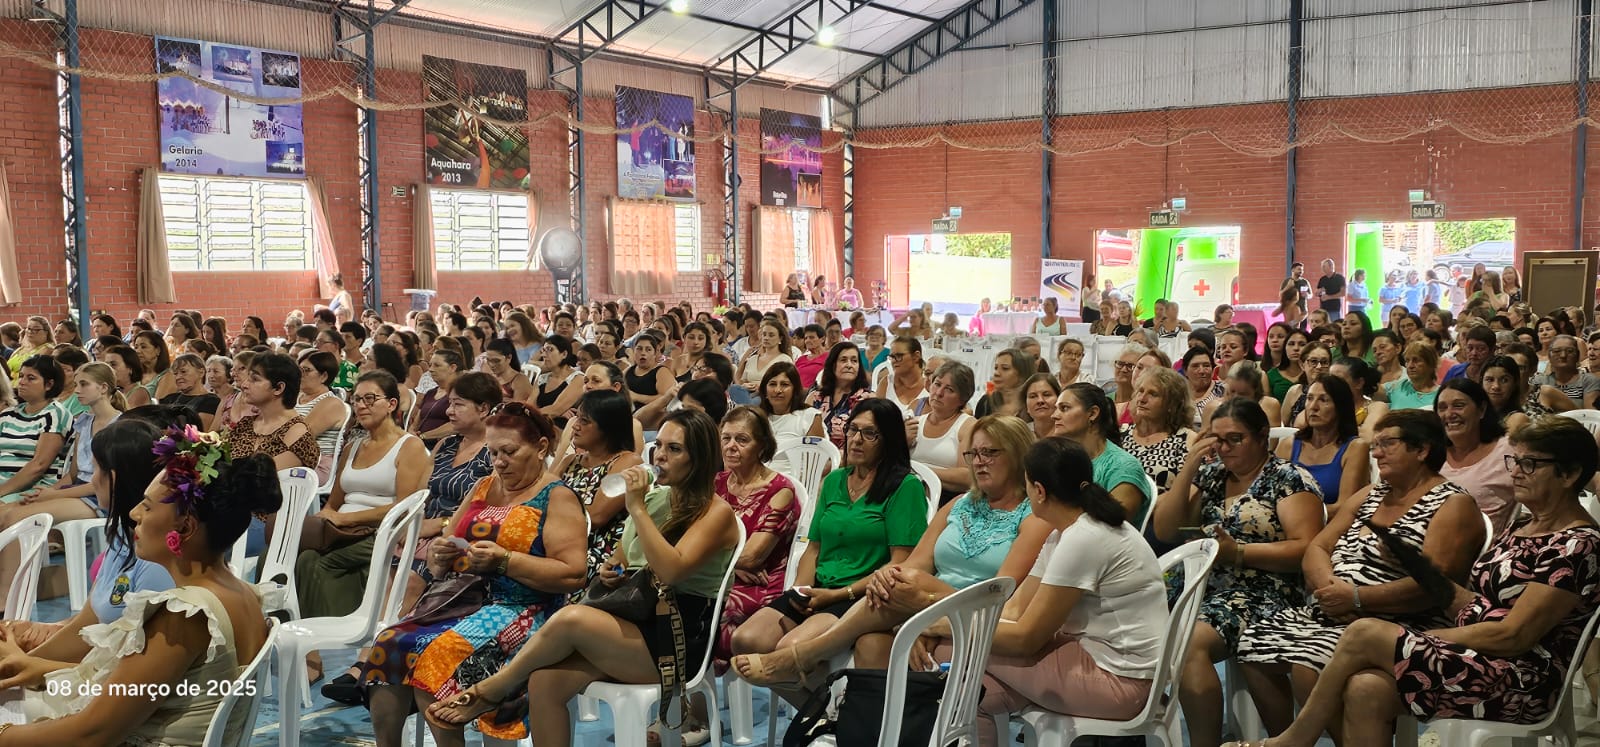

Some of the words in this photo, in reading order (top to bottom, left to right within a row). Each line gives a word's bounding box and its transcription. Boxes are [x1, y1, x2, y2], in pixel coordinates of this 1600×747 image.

[169, 144, 203, 155] Gelaria
[175, 158, 198, 168] 2014
[431, 157, 471, 170] Aquahara
[441, 172, 461, 183] 2013
